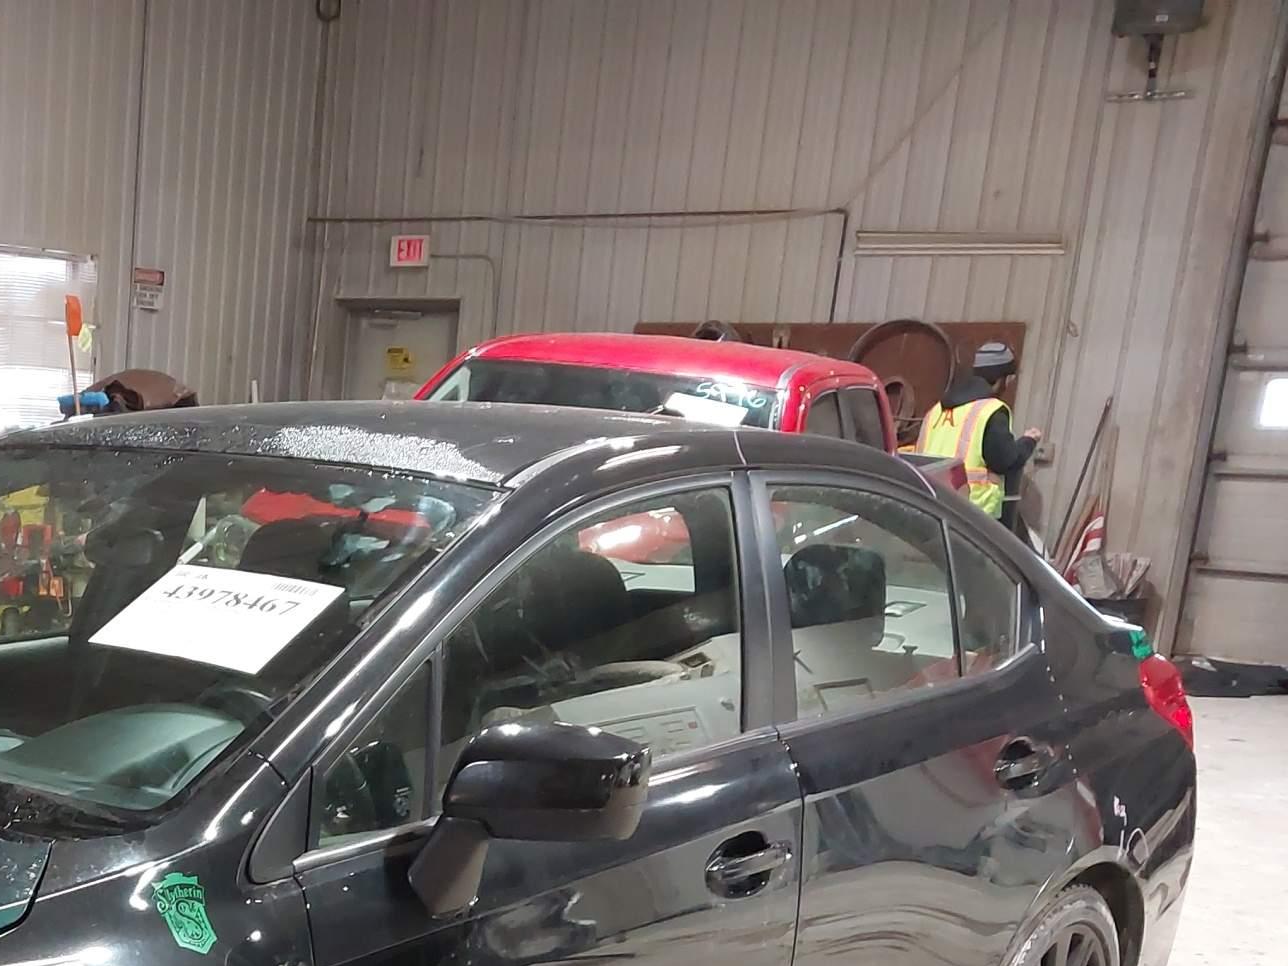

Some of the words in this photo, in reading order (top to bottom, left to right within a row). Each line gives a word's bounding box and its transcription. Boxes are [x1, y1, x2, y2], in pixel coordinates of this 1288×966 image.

[397, 239, 424, 262] EXIT
[162, 584, 301, 616] 43978467
[156, 885, 203, 914] Slytherin
